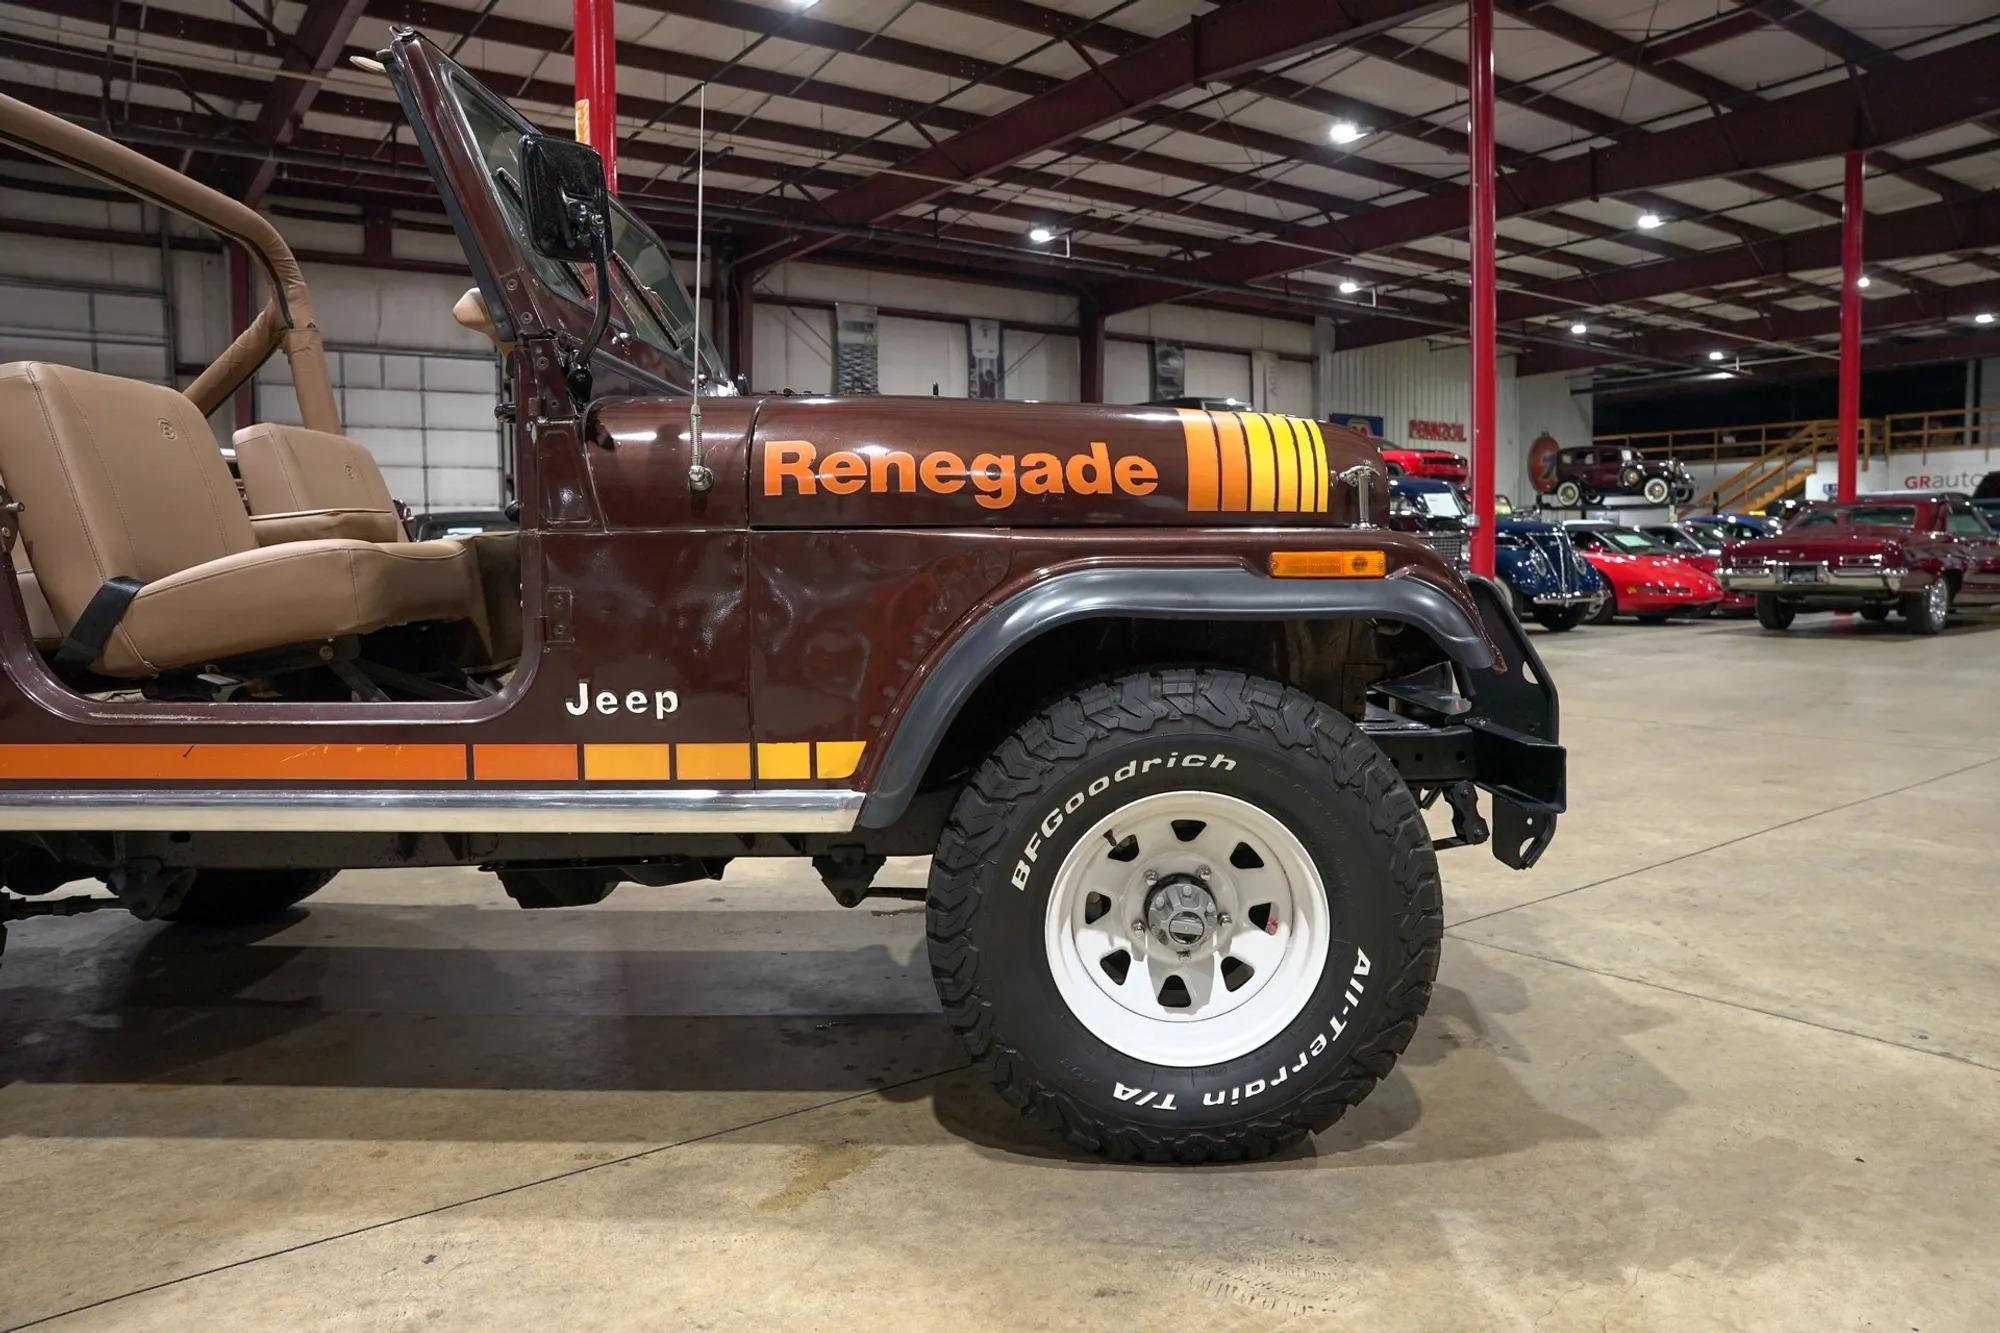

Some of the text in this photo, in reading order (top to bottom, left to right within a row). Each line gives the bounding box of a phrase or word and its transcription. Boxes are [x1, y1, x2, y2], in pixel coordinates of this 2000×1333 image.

[763, 440, 1159, 509] Renegade
[565, 682, 679, 720] Jeep
[1010, 752, 1238, 892] BFGoodrich
[1112, 947, 1373, 1111] All-Terrain T/A
